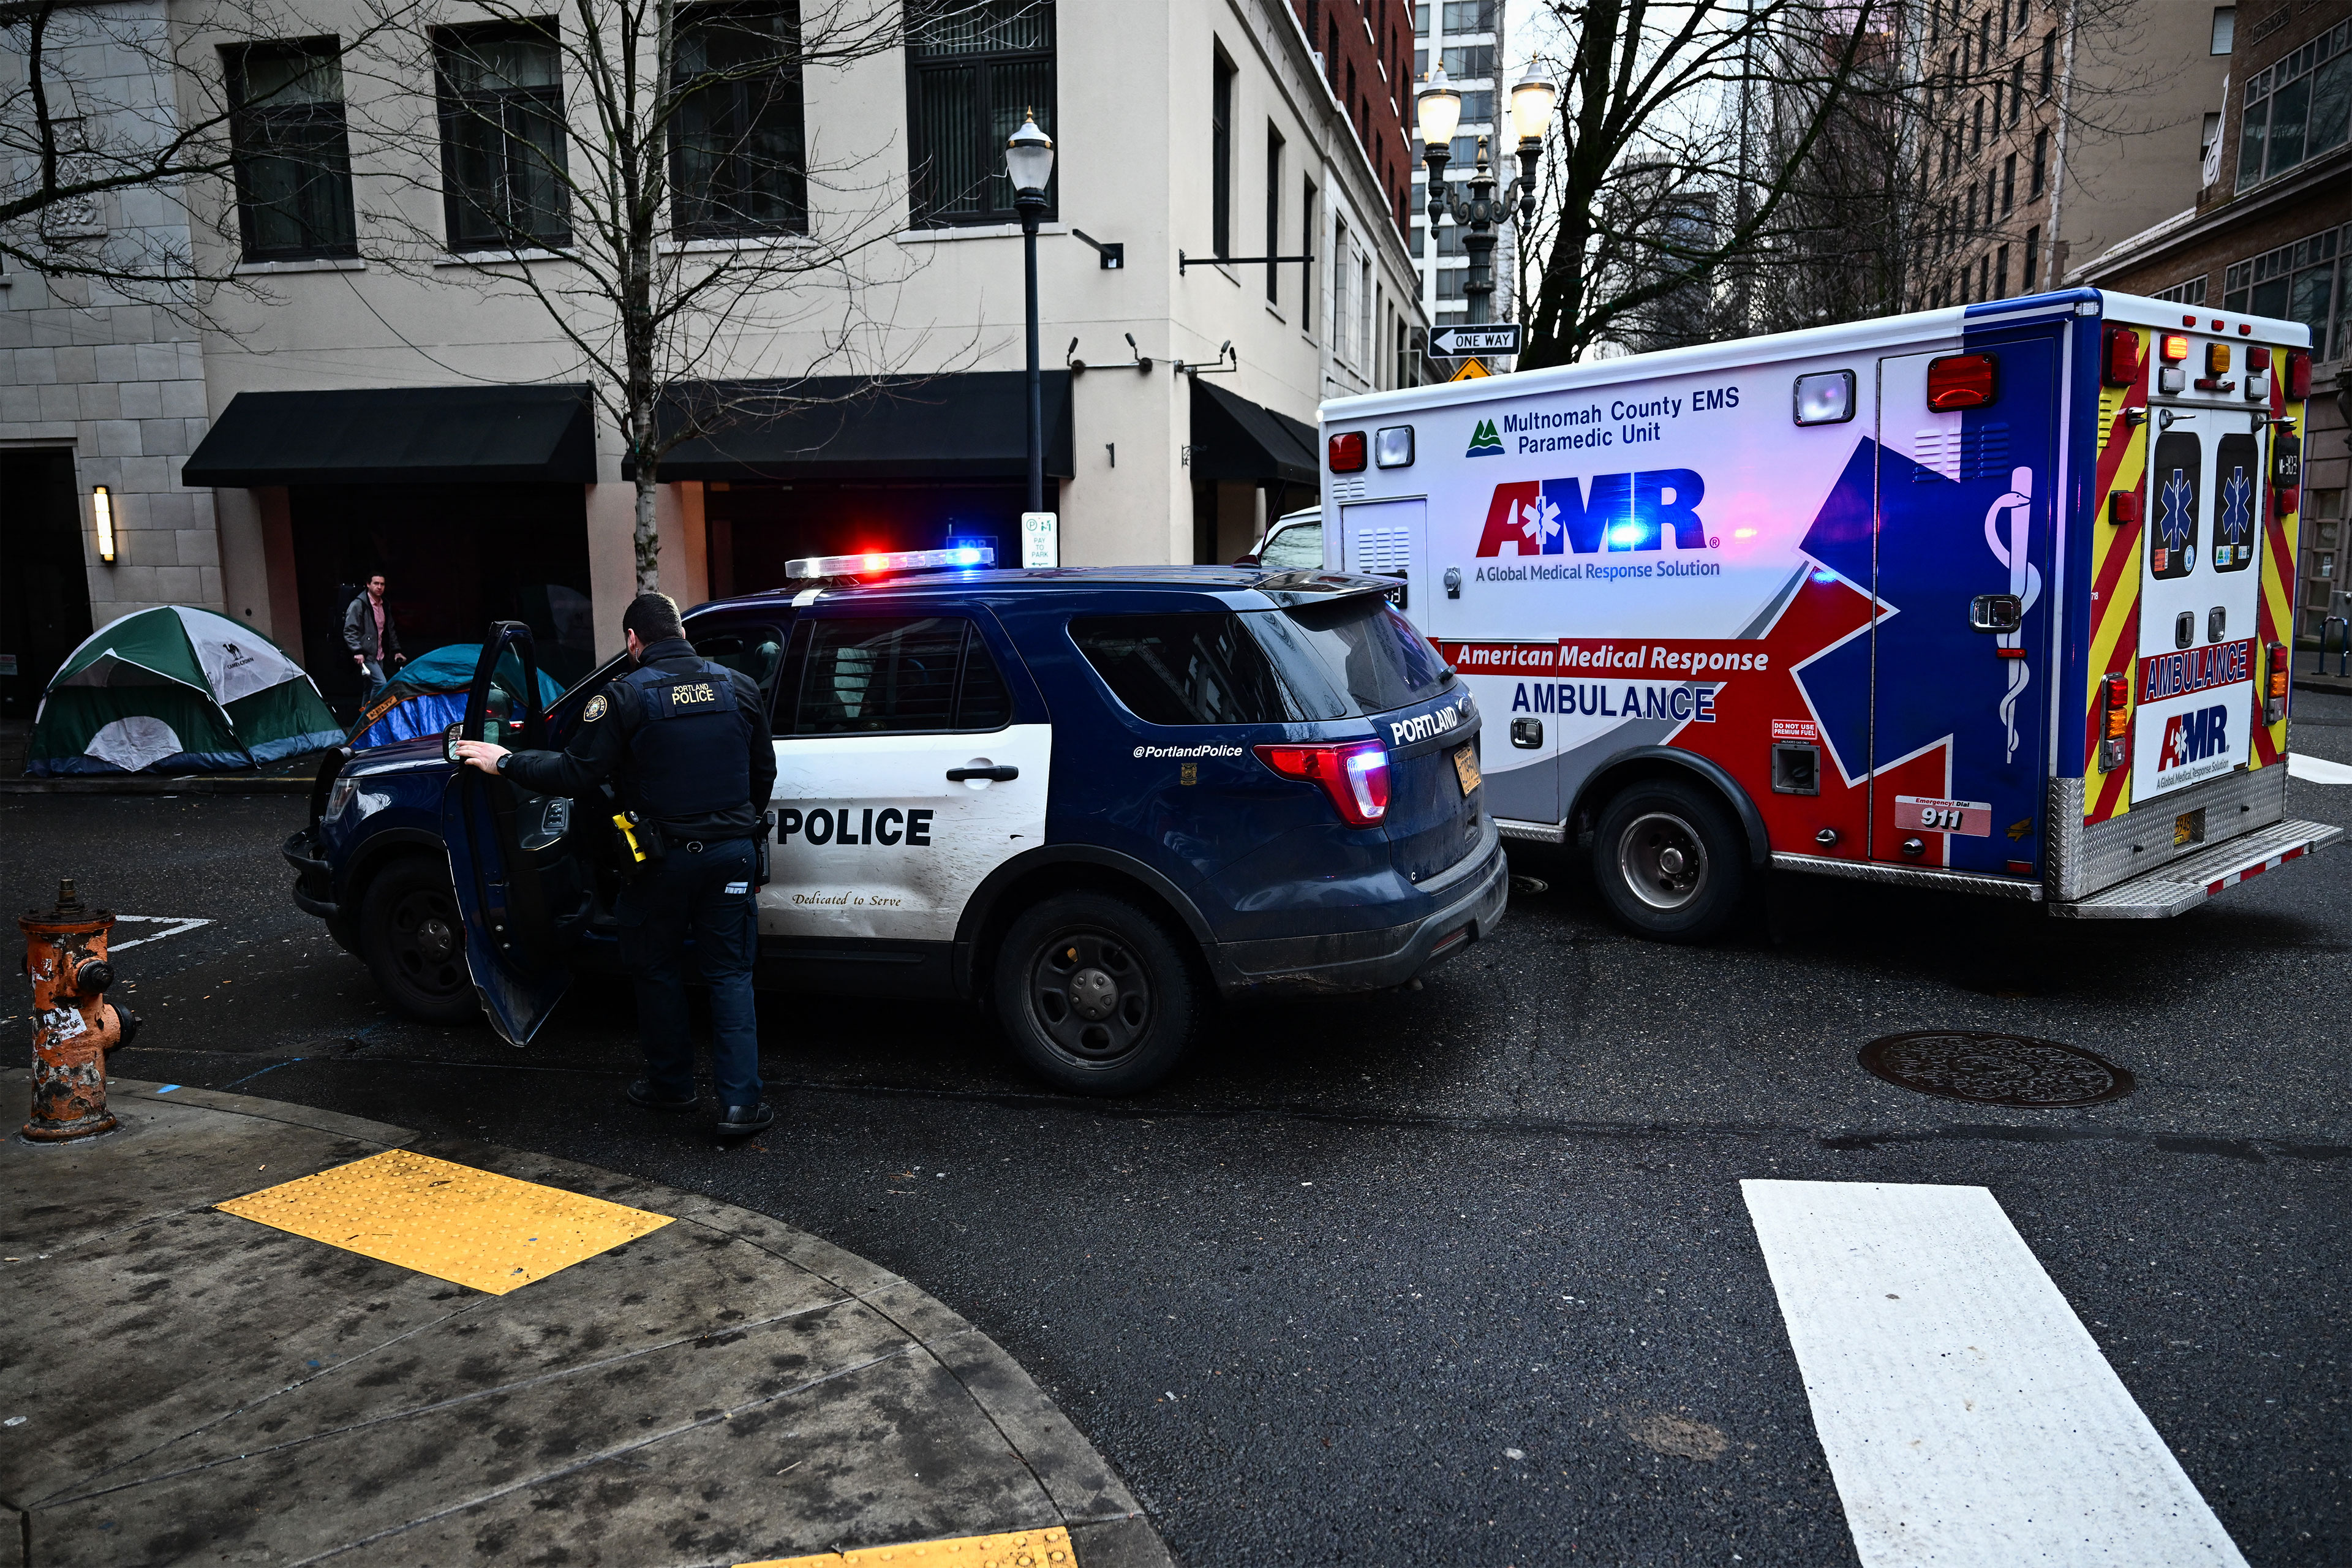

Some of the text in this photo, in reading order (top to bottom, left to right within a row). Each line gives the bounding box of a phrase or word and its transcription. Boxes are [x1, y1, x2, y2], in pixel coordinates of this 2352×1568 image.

[1456, 334, 1510, 347] ONE WAY
[1504, 386, 1740, 433] Multnomah County EMS
[1518, 423, 1660, 454] Paramedic Unit
[1476, 559, 1720, 582] A Global Medical Response Solution
[1457, 644, 1768, 677] American Medical Response
[2145, 641, 2247, 701] AMBULANCE
[672, 690, 715, 705] POLICE
[674, 684, 709, 693] PORTLAND
[1512, 682, 1716, 722] AMBULANCE
[1390, 706, 1457, 745] PORTLAND
[1133, 745, 1243, 758] @PortlandPolice
[2156, 779, 2160, 789] A
[2161, 774, 2175, 787] Global
[2175, 770, 2192, 784] Medical
[2212, 759, 2229, 772] Solution
[777, 808, 933, 846] POLICE
[1921, 807, 1963, 831] 911
[1411, 872, 1416, 881] C
[792, 891, 901, 907] Dedicated to Serve
